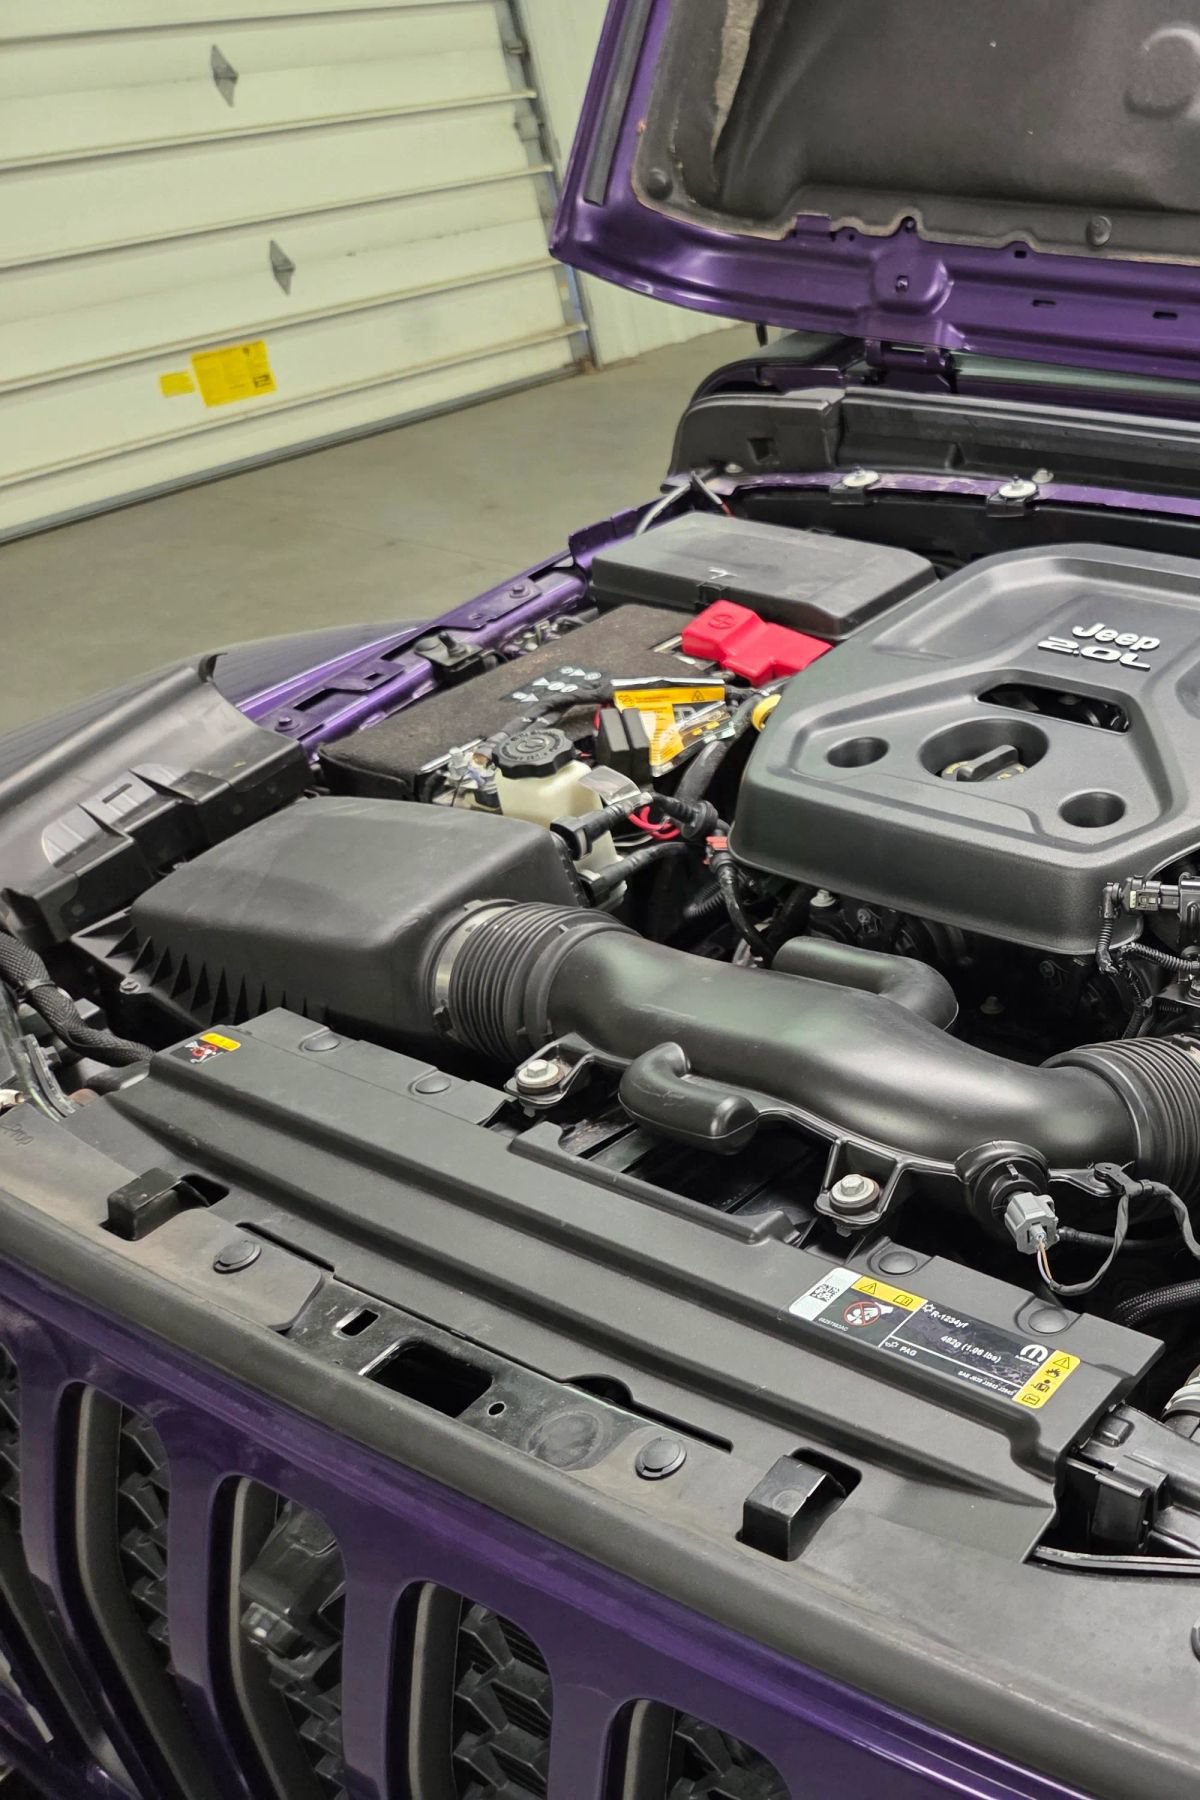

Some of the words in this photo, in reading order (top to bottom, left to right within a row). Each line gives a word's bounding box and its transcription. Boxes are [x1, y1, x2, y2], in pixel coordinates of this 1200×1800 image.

[1071, 622, 1160, 652] Jeep
[1037, 636, 1151, 672] 2.0L
[930, 1310, 969, 1329] R-1234yf
[899, 1346, 918, 1357] PAG
[982, 1351, 1002, 1364] lbs)
